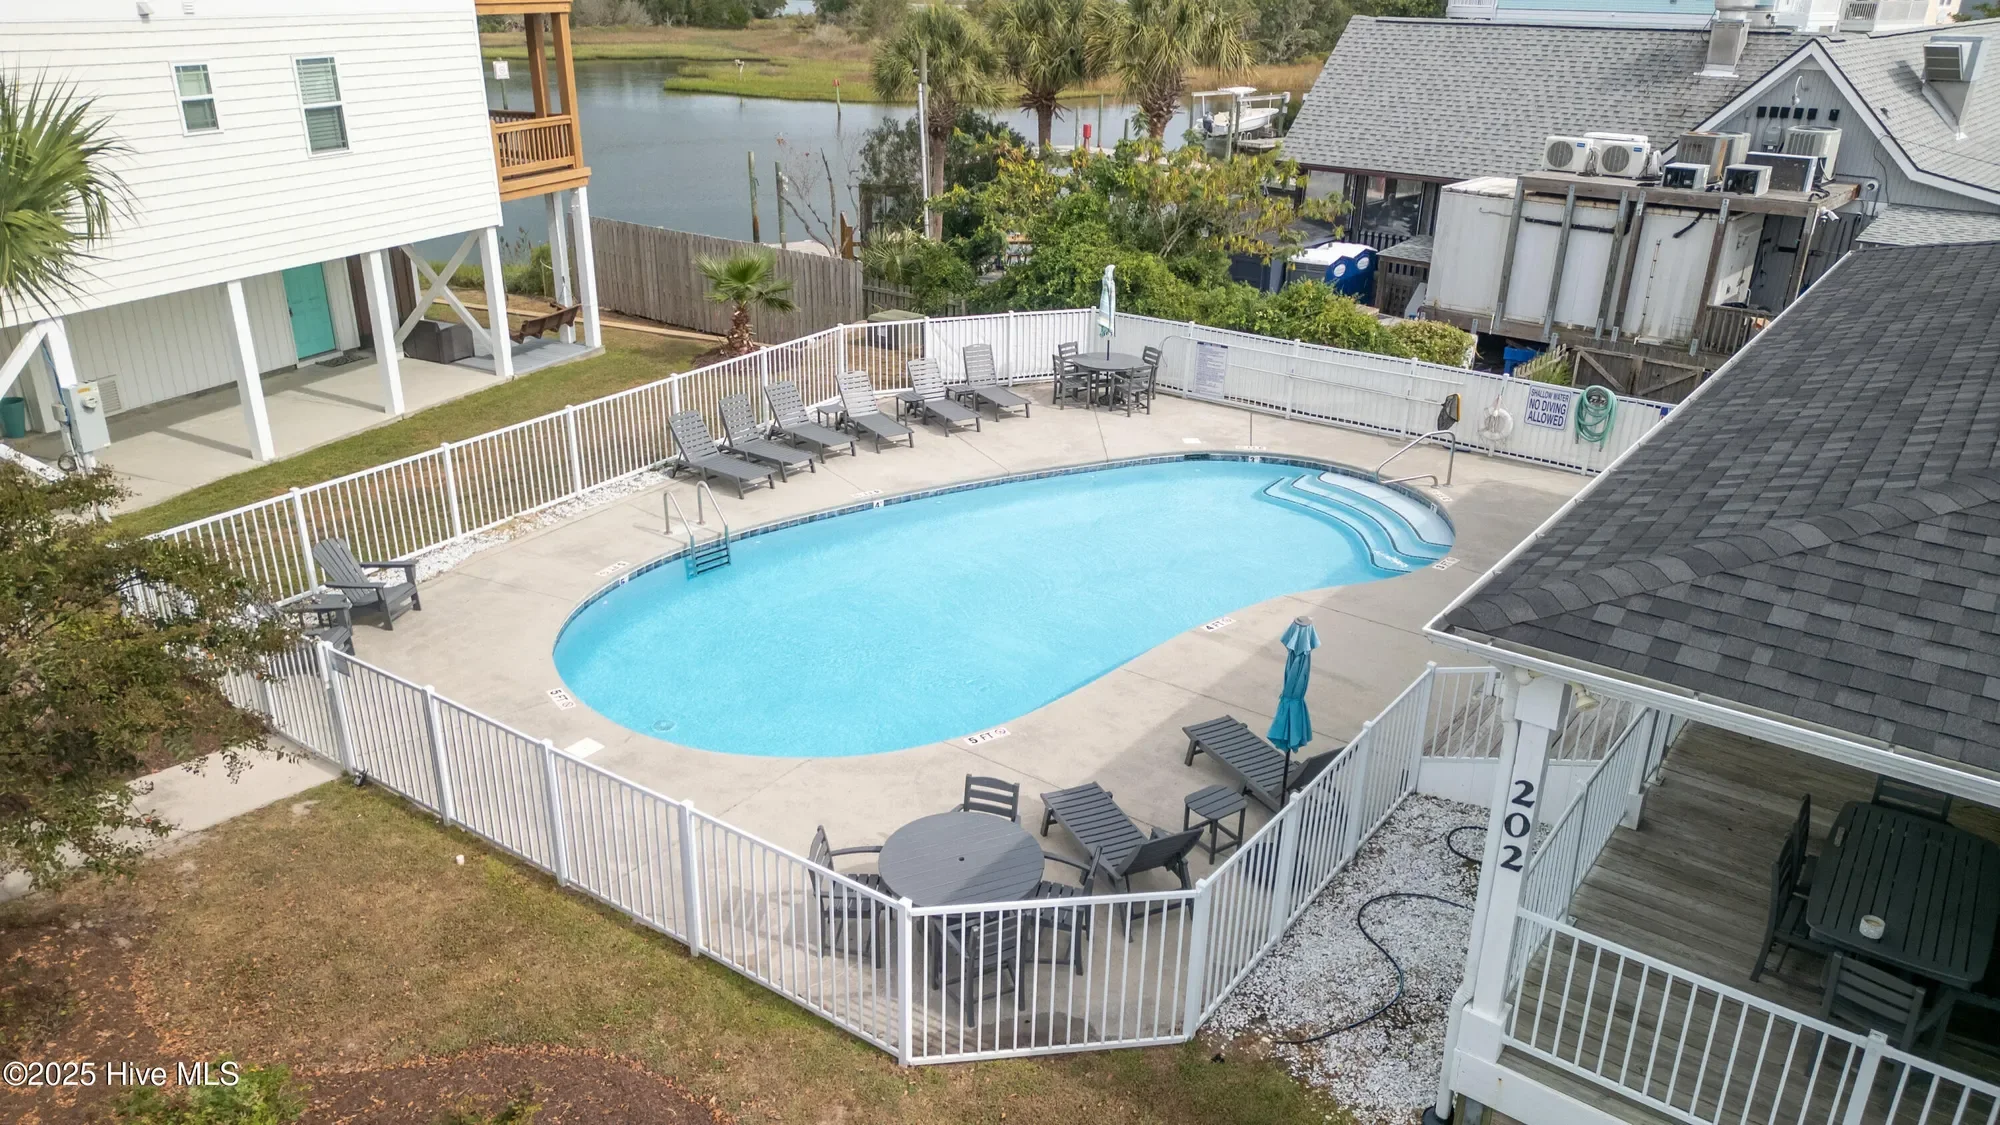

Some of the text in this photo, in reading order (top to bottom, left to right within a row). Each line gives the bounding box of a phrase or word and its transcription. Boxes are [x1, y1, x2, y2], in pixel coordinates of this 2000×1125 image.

[1531, 389, 1569, 402] SHALLOW WATER
[1529, 398, 1567, 415] NO DIVING
[1527, 411, 1564, 426] ALLOWED
[980, 732, 993, 741] FT
[1500, 780, 1535, 872] 202
